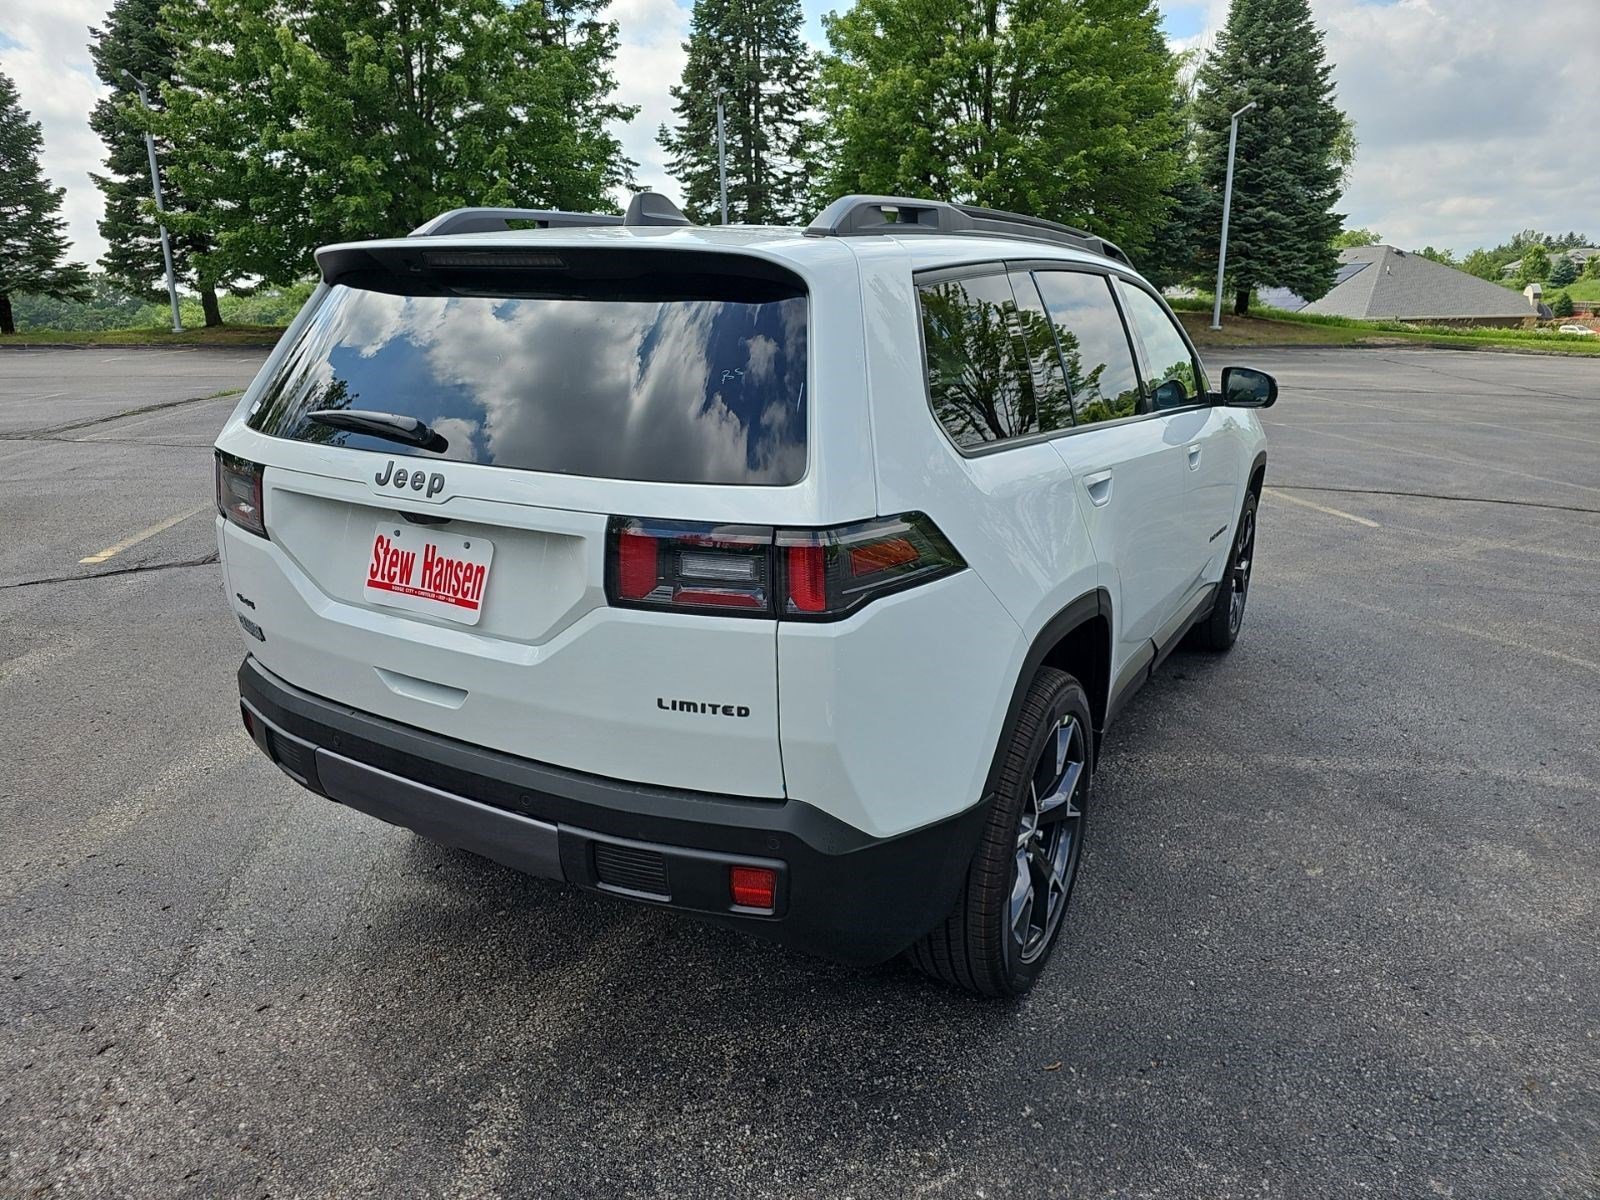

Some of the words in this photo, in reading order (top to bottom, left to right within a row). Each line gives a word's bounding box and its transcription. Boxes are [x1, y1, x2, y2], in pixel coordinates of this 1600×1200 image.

[375, 461, 445, 498] Jeep
[370, 535, 416, 585] Stew
[421, 544, 486, 601] Hansen
[657, 698, 750, 717] LIMITED
